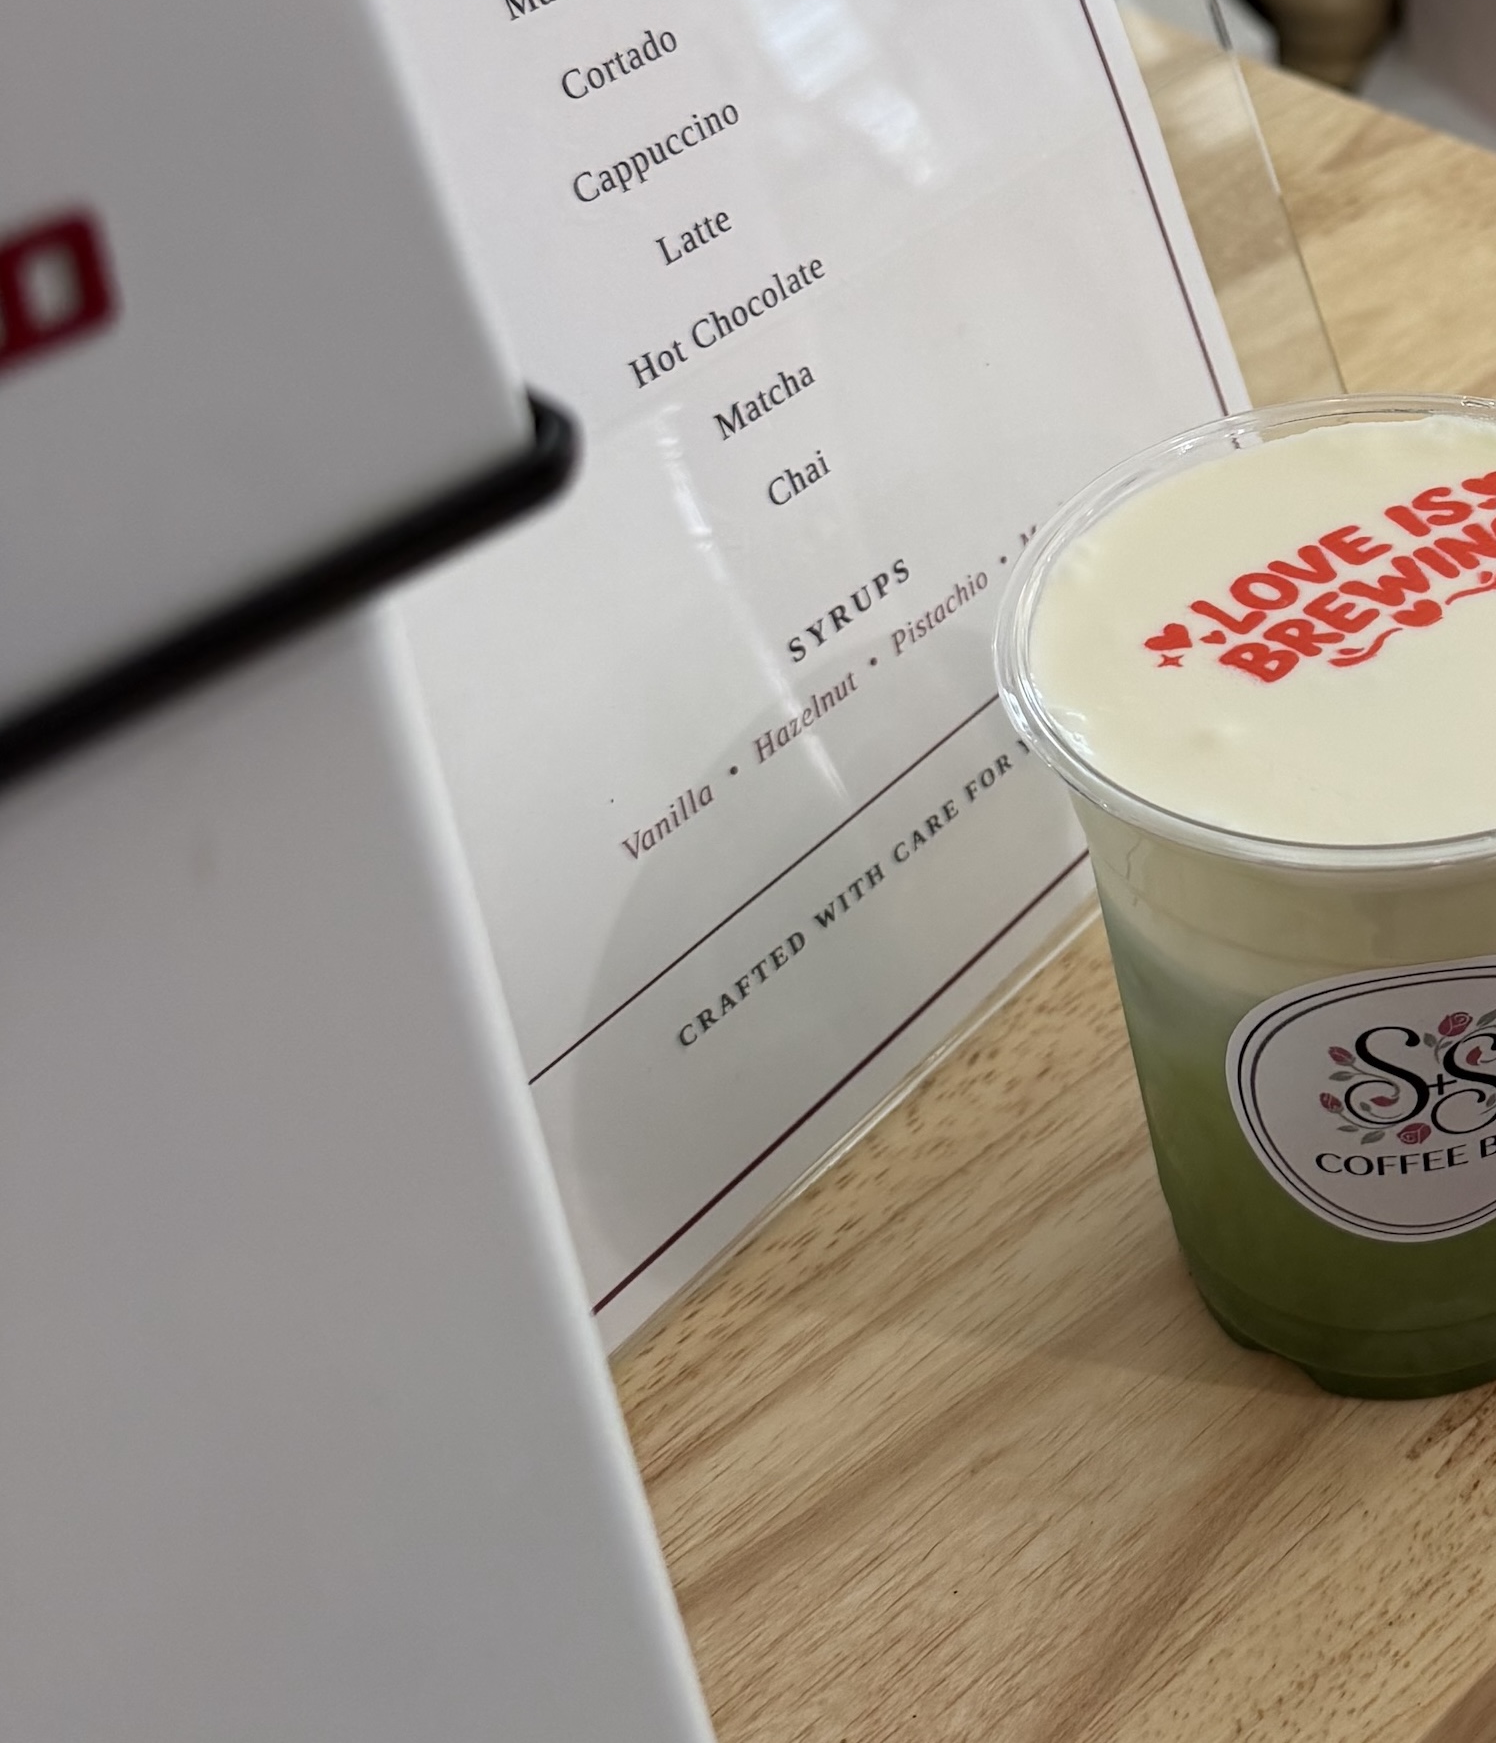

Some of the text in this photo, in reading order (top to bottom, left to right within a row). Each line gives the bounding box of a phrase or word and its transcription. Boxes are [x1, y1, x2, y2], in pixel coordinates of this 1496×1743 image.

[560, 27, 678, 101] Cortado
[571, 102, 740, 203] Cappuccino
[655, 210, 734, 266] Latte
[627, 256, 827, 389] Hot Chocolate
[712, 364, 816, 441] Matcha
[766, 449, 832, 507] Chai
[787, 558, 911, 663] SYRUPS
[1189, 486, 1472, 635] LOVE IS
[620, 569, 989, 862] Vanilla Hazelnut Pistachio
[675, 751, 1015, 1049] CRAFTED WITH CARE FOR
[1315, 1143, 1470, 1176] COFFEE
